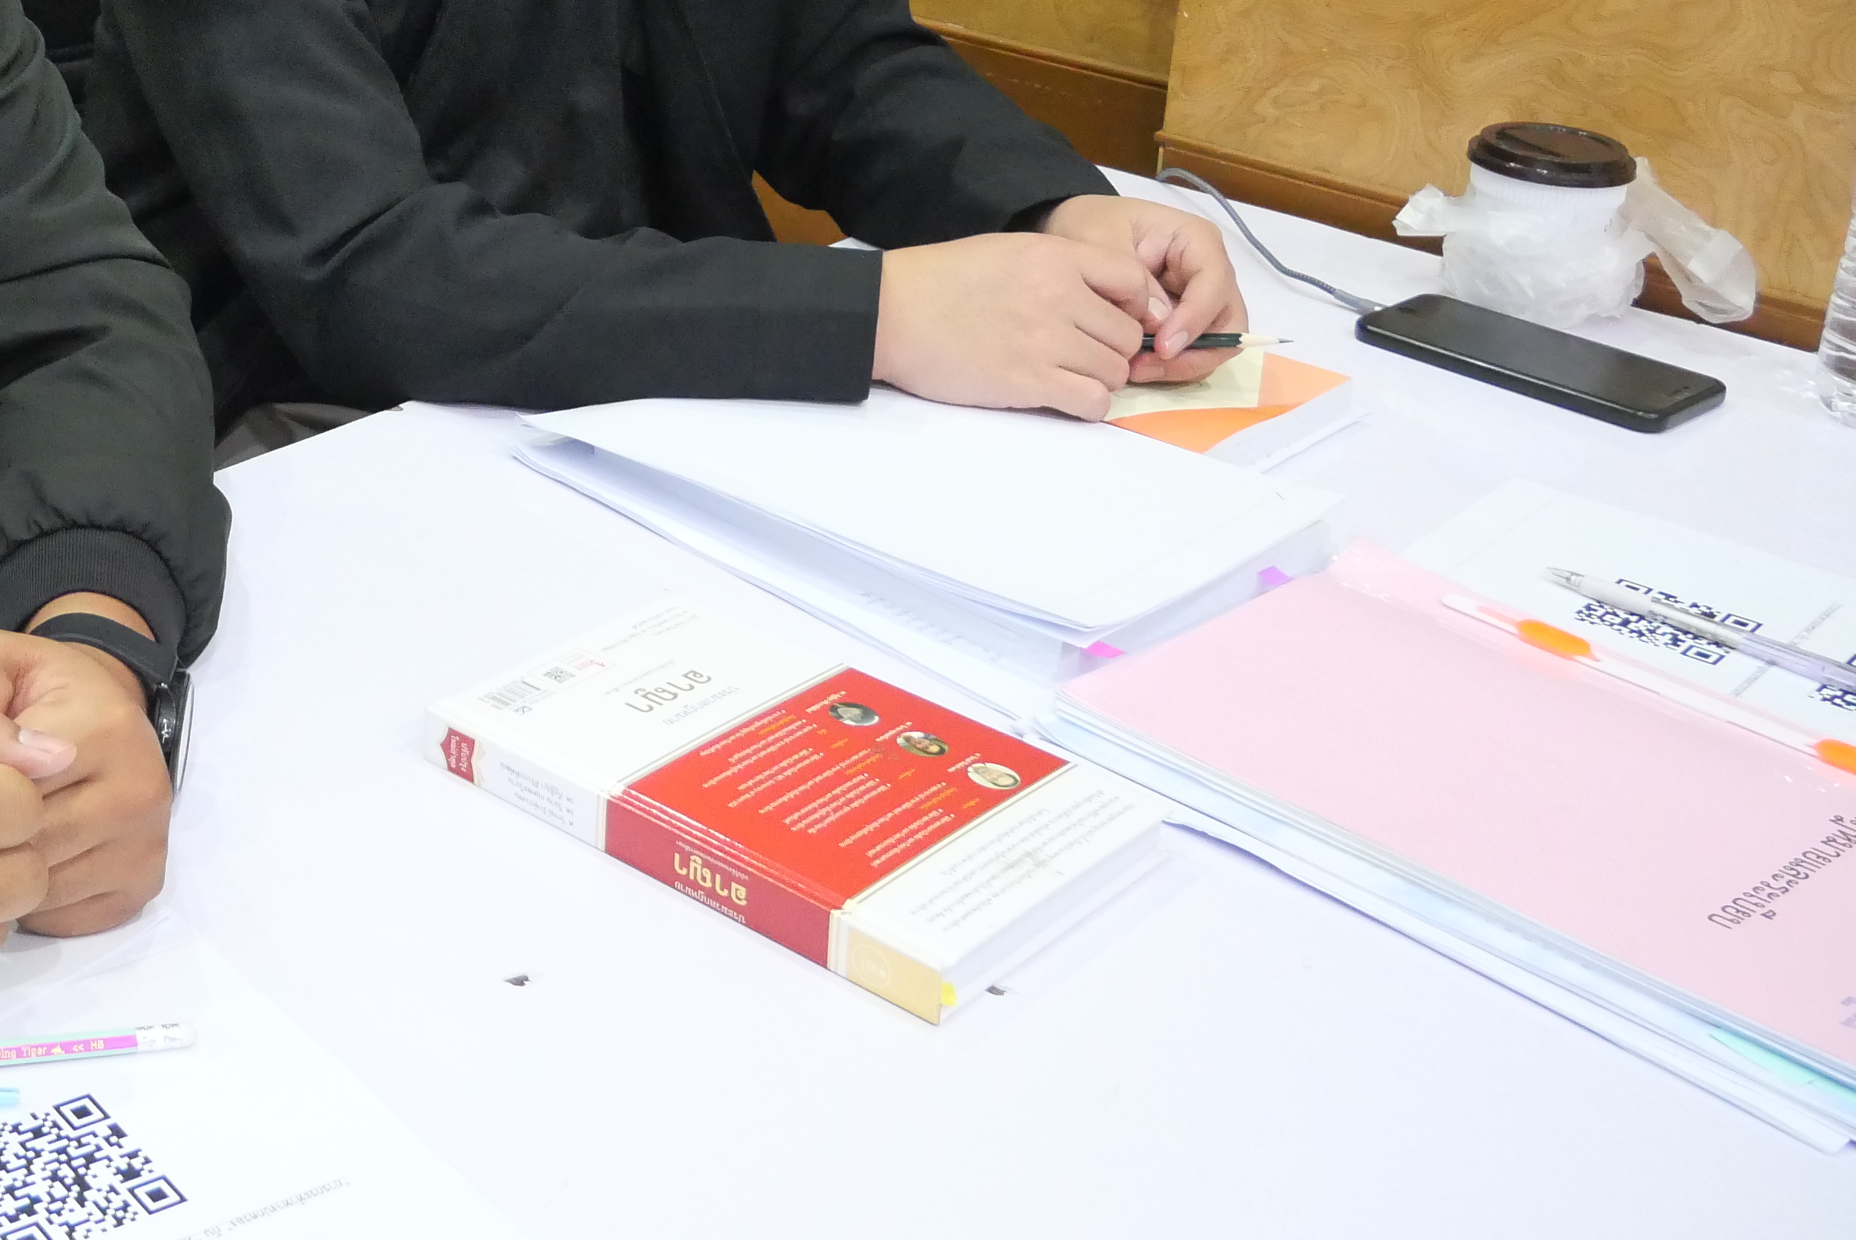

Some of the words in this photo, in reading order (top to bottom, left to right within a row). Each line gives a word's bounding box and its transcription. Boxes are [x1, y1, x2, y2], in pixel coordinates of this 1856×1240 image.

[624, 669, 712, 714] อาญา
[674, 852, 748, 906] อาญา
[1707, 815, 1856, 930] ฎหมายและระเบียบ
[674, 880, 747, 924] ประมวลกฎหมาย
[21, 1045, 48, 1059] Tiger
[90, 1039, 105, 1051] HB
